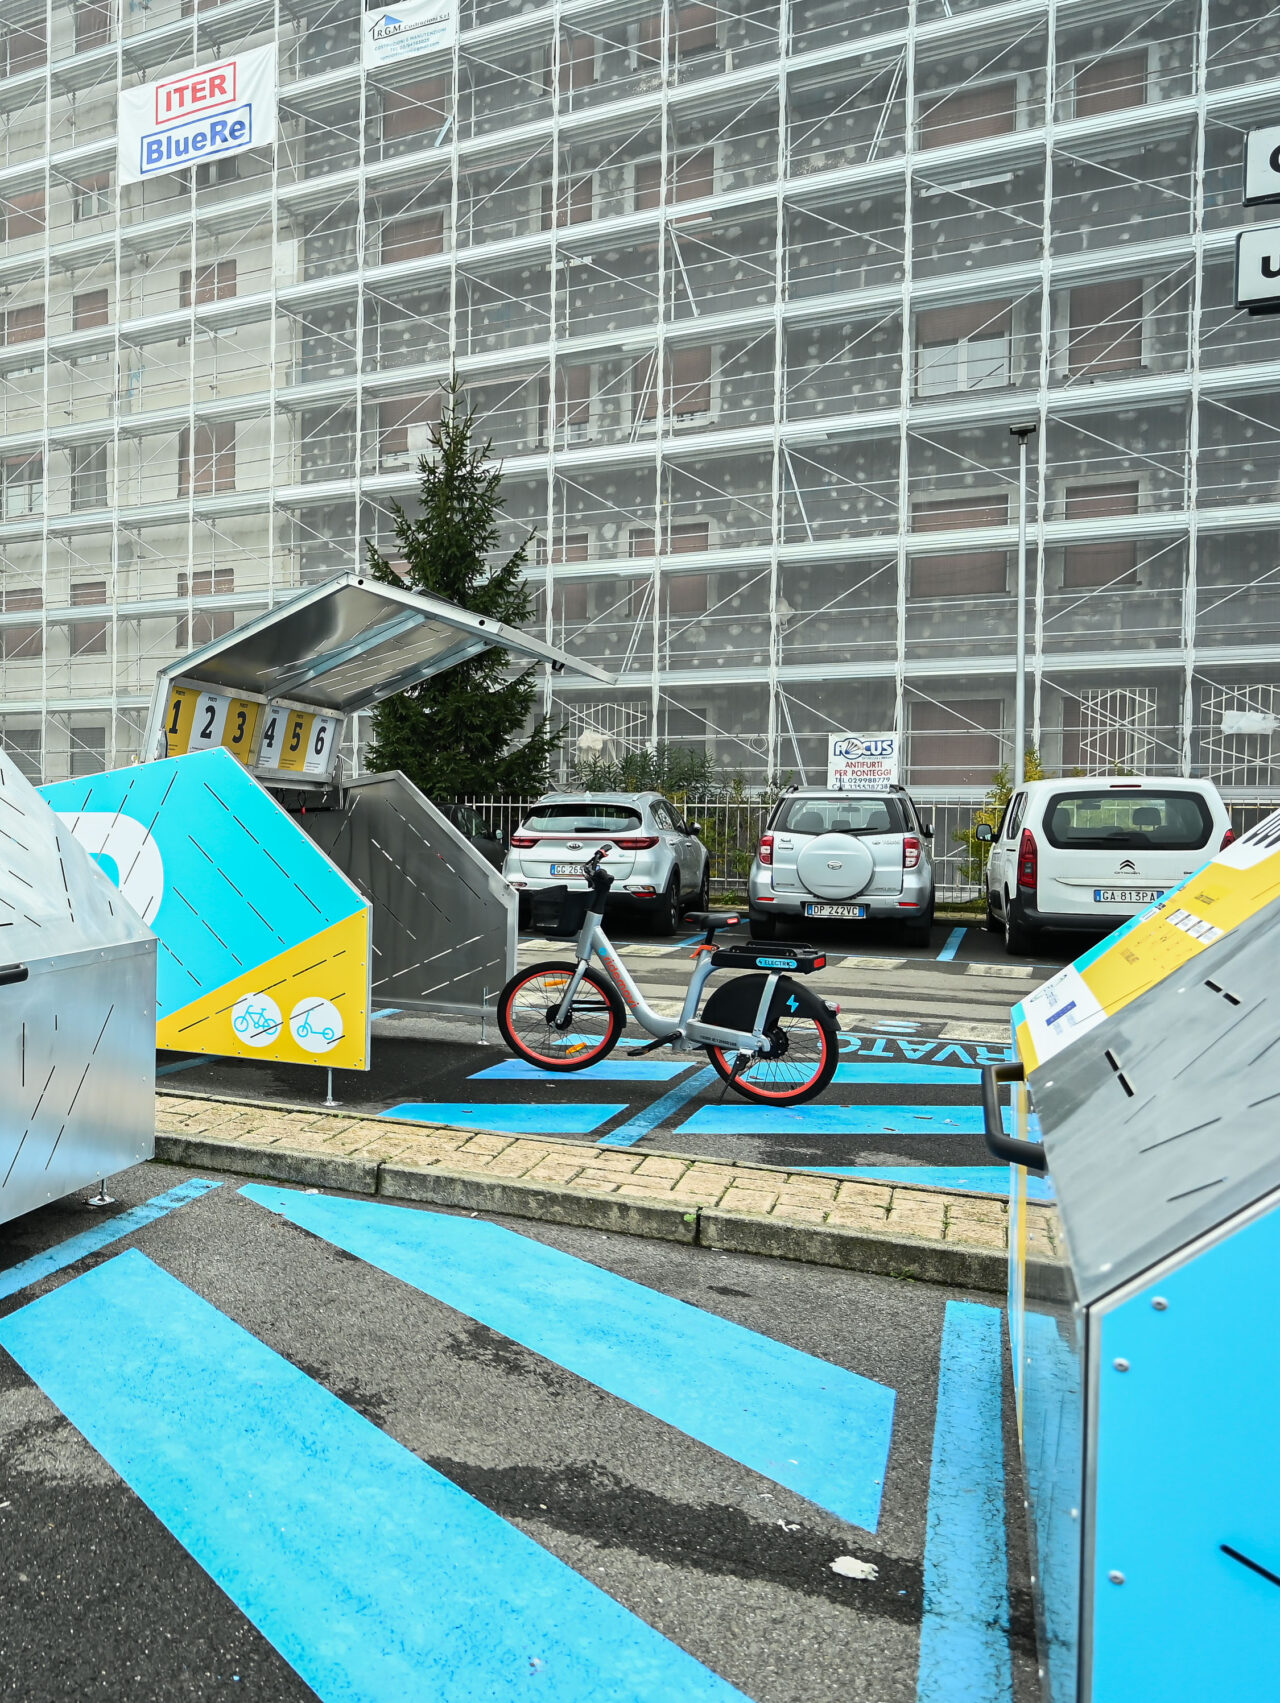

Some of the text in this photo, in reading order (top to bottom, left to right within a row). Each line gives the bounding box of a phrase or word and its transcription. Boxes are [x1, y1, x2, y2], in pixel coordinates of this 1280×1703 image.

[166, 74, 227, 112] ITER
[146, 120, 246, 165] BlueRe
[168, 699, 328, 755] 1 2 3 4 5 6
[845, 761, 883, 769] ANTIFURTI
[834, 769, 892, 777] PER PONTEGGI
[1102, 892, 1116, 901] GA
[813, 906, 858, 915] DP 242VC
[764, 959, 793, 967] ELECTRIC
[602, 956, 640, 1009] ridemovi
